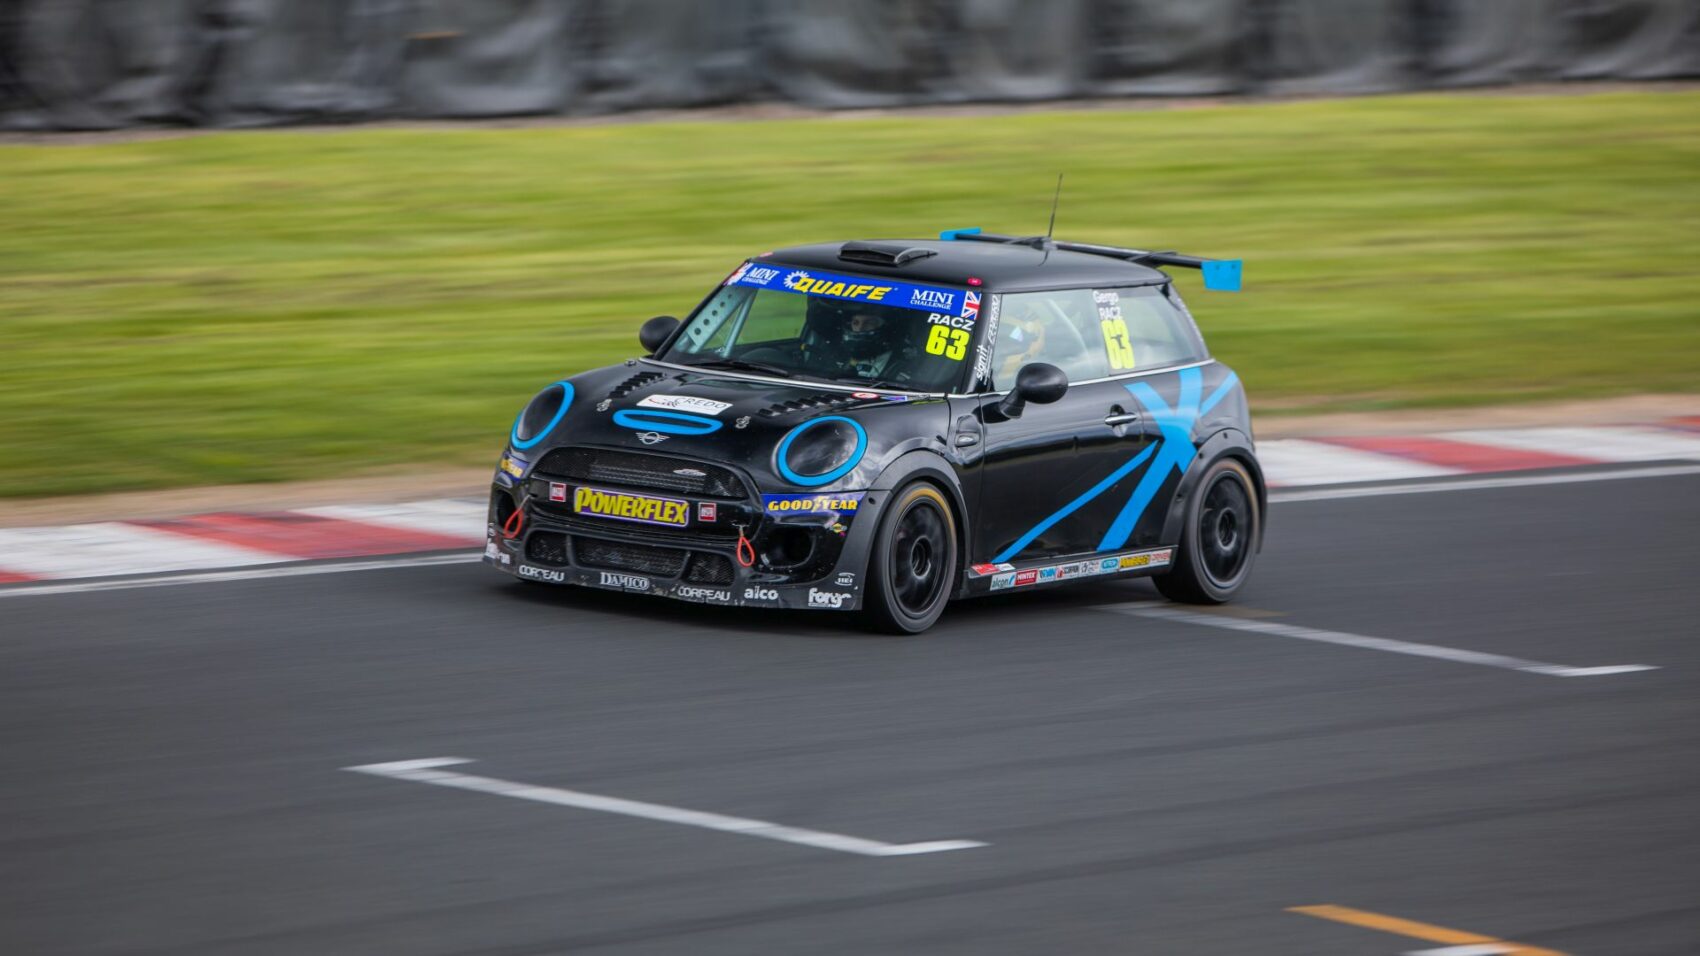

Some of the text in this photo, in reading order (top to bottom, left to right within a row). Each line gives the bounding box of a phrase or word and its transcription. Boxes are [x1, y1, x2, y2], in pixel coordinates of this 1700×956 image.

[746, 267, 780, 281] MINI
[793, 276, 892, 301] QUAIFE
[911, 288, 955, 304] MINI
[910, 299, 952, 310] CHALLENGE
[927, 312, 976, 332] RACZ
[925, 324, 970, 361] 63
[674, 397, 728, 409] CREDO
[574, 486, 690, 524] POWERFLEX
[600, 572, 650, 590] DAMICO
